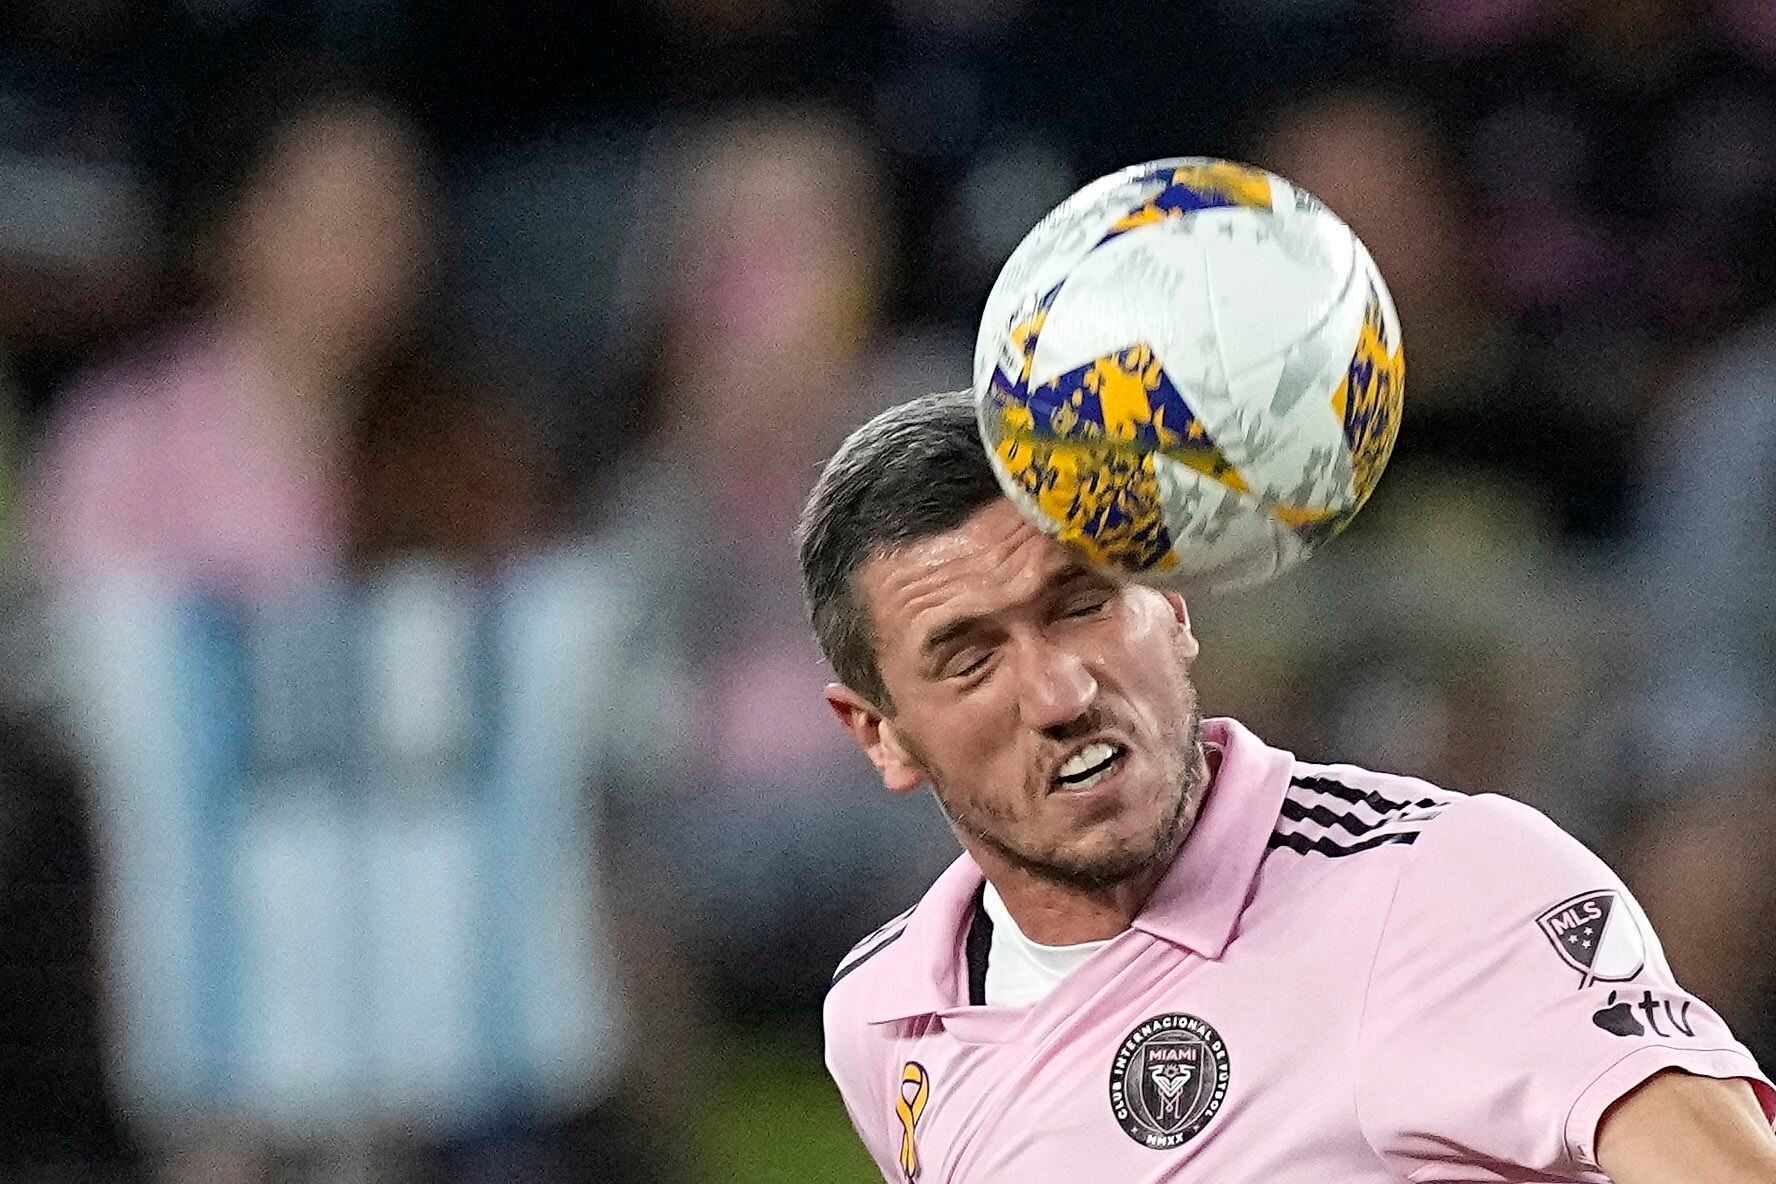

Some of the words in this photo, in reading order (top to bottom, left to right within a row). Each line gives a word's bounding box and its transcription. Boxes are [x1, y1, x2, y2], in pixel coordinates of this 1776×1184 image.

[1551, 901, 1602, 936] MLS
[1639, 990, 1695, 1038] tv
[1113, 1016, 1213, 1076] INTERNACIONAL
[1149, 1049, 1197, 1062] MIAMI
[1213, 1040, 1227, 1060] DE
[1112, 1081, 1128, 1120] CLUB
[1146, 1132, 1184, 1147] MMXX
